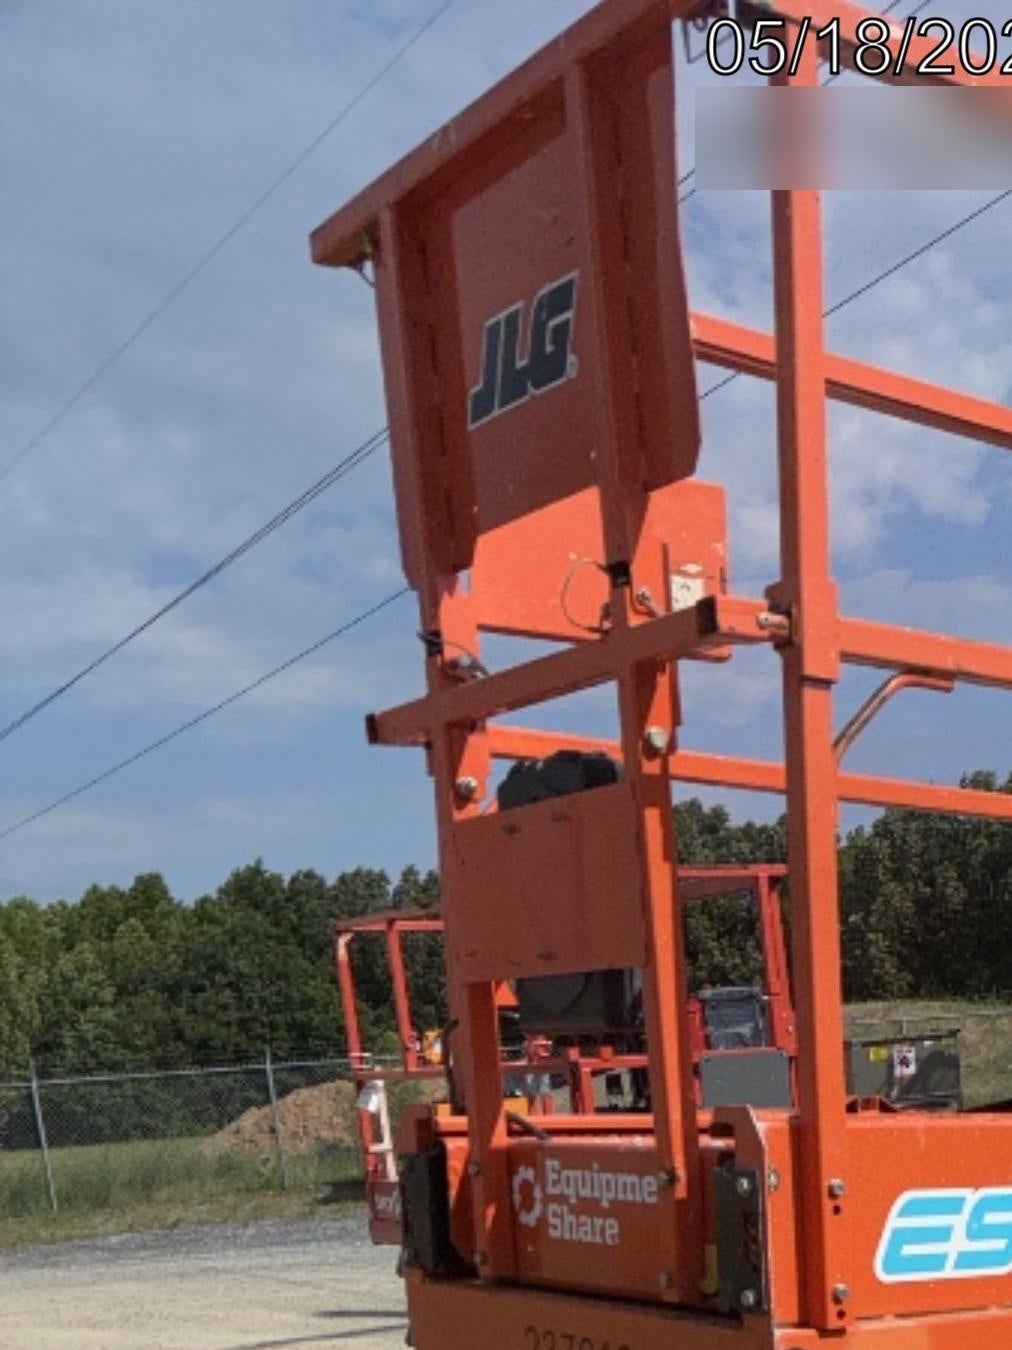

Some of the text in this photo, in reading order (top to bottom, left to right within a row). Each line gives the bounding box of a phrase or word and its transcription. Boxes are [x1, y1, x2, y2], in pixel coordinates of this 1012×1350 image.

[468, 270, 580, 432] JLG
[545, 1159, 658, 1208] Equipme
[548, 1203, 619, 1246] Share
